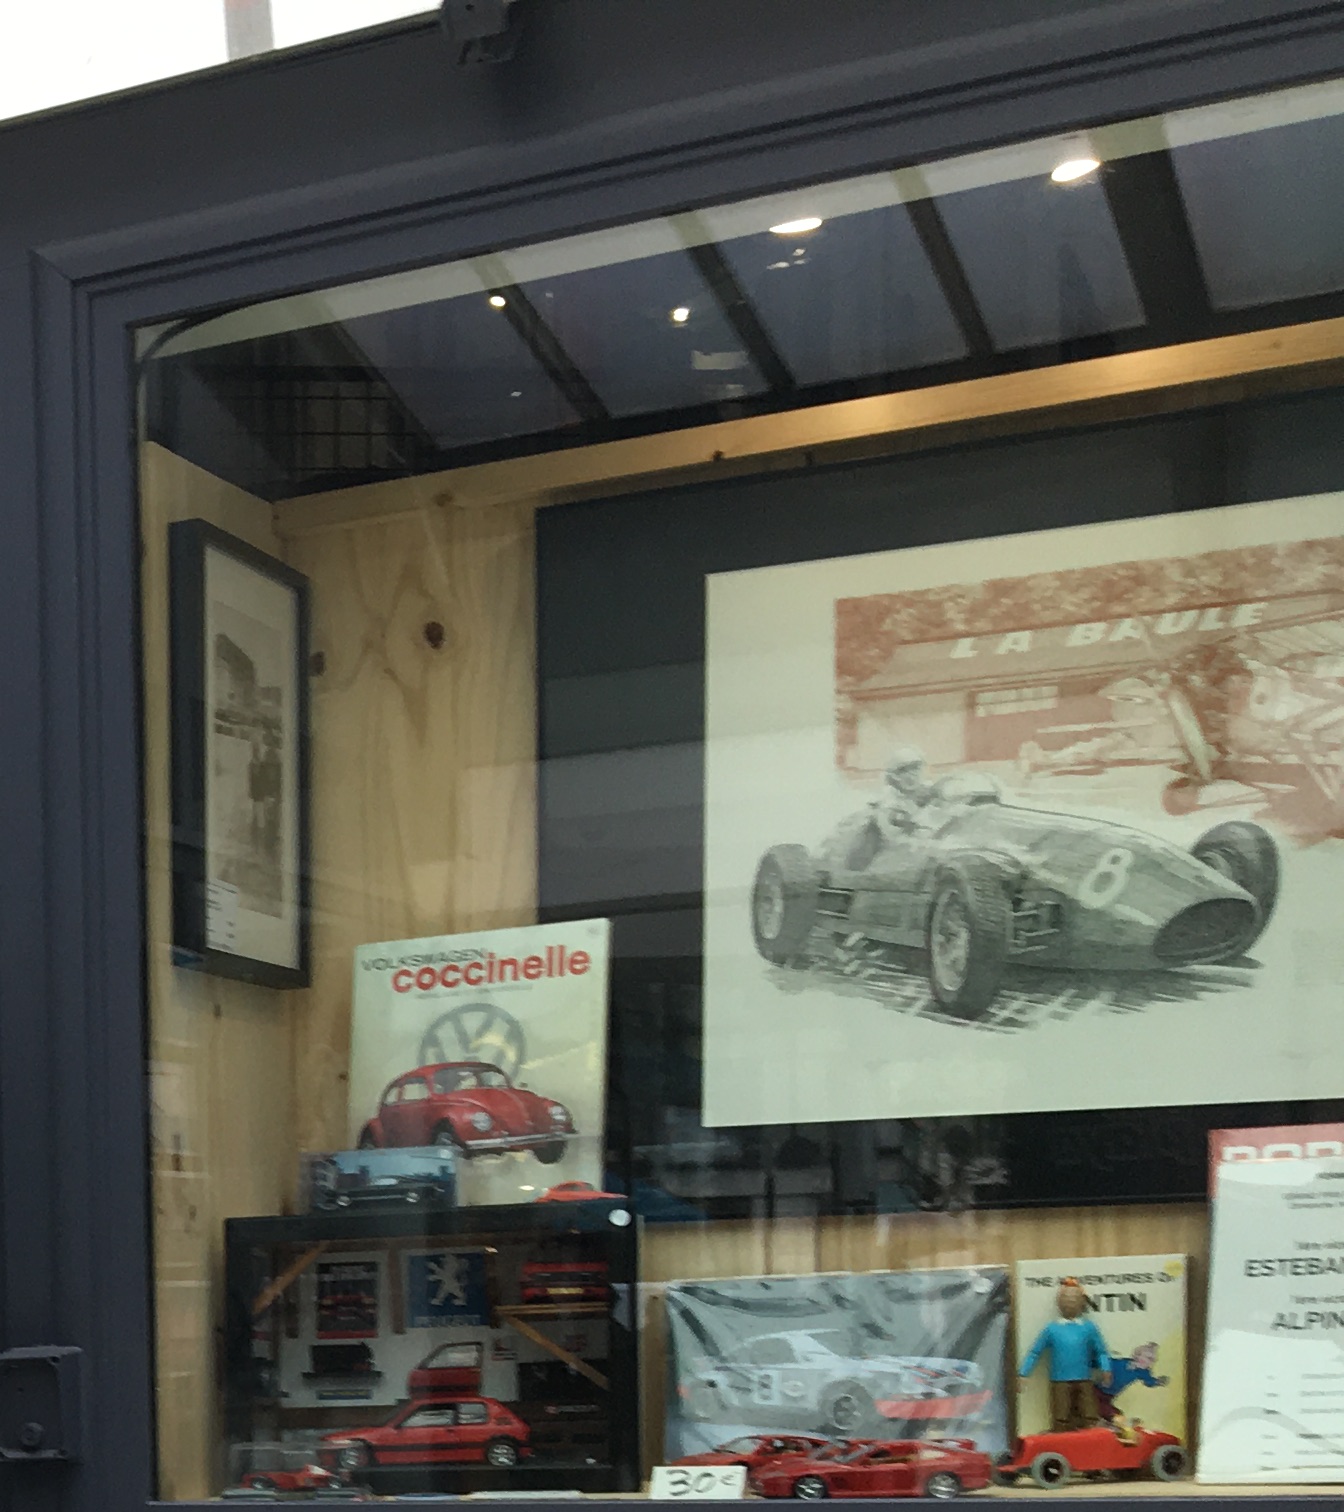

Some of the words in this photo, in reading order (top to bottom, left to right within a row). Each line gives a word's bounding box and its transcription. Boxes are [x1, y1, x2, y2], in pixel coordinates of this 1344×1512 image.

[950, 631, 1033, 659] LA
[1066, 602, 1269, 647] BAULE
[1078, 849, 1134, 908] 8
[362, 949, 488, 972] VOLKSWAGEN
[392, 944, 592, 993] coccinelle
[1024, 1276, 1055, 1288] THE
[1244, 1257, 1344, 1278] ESTEBA
